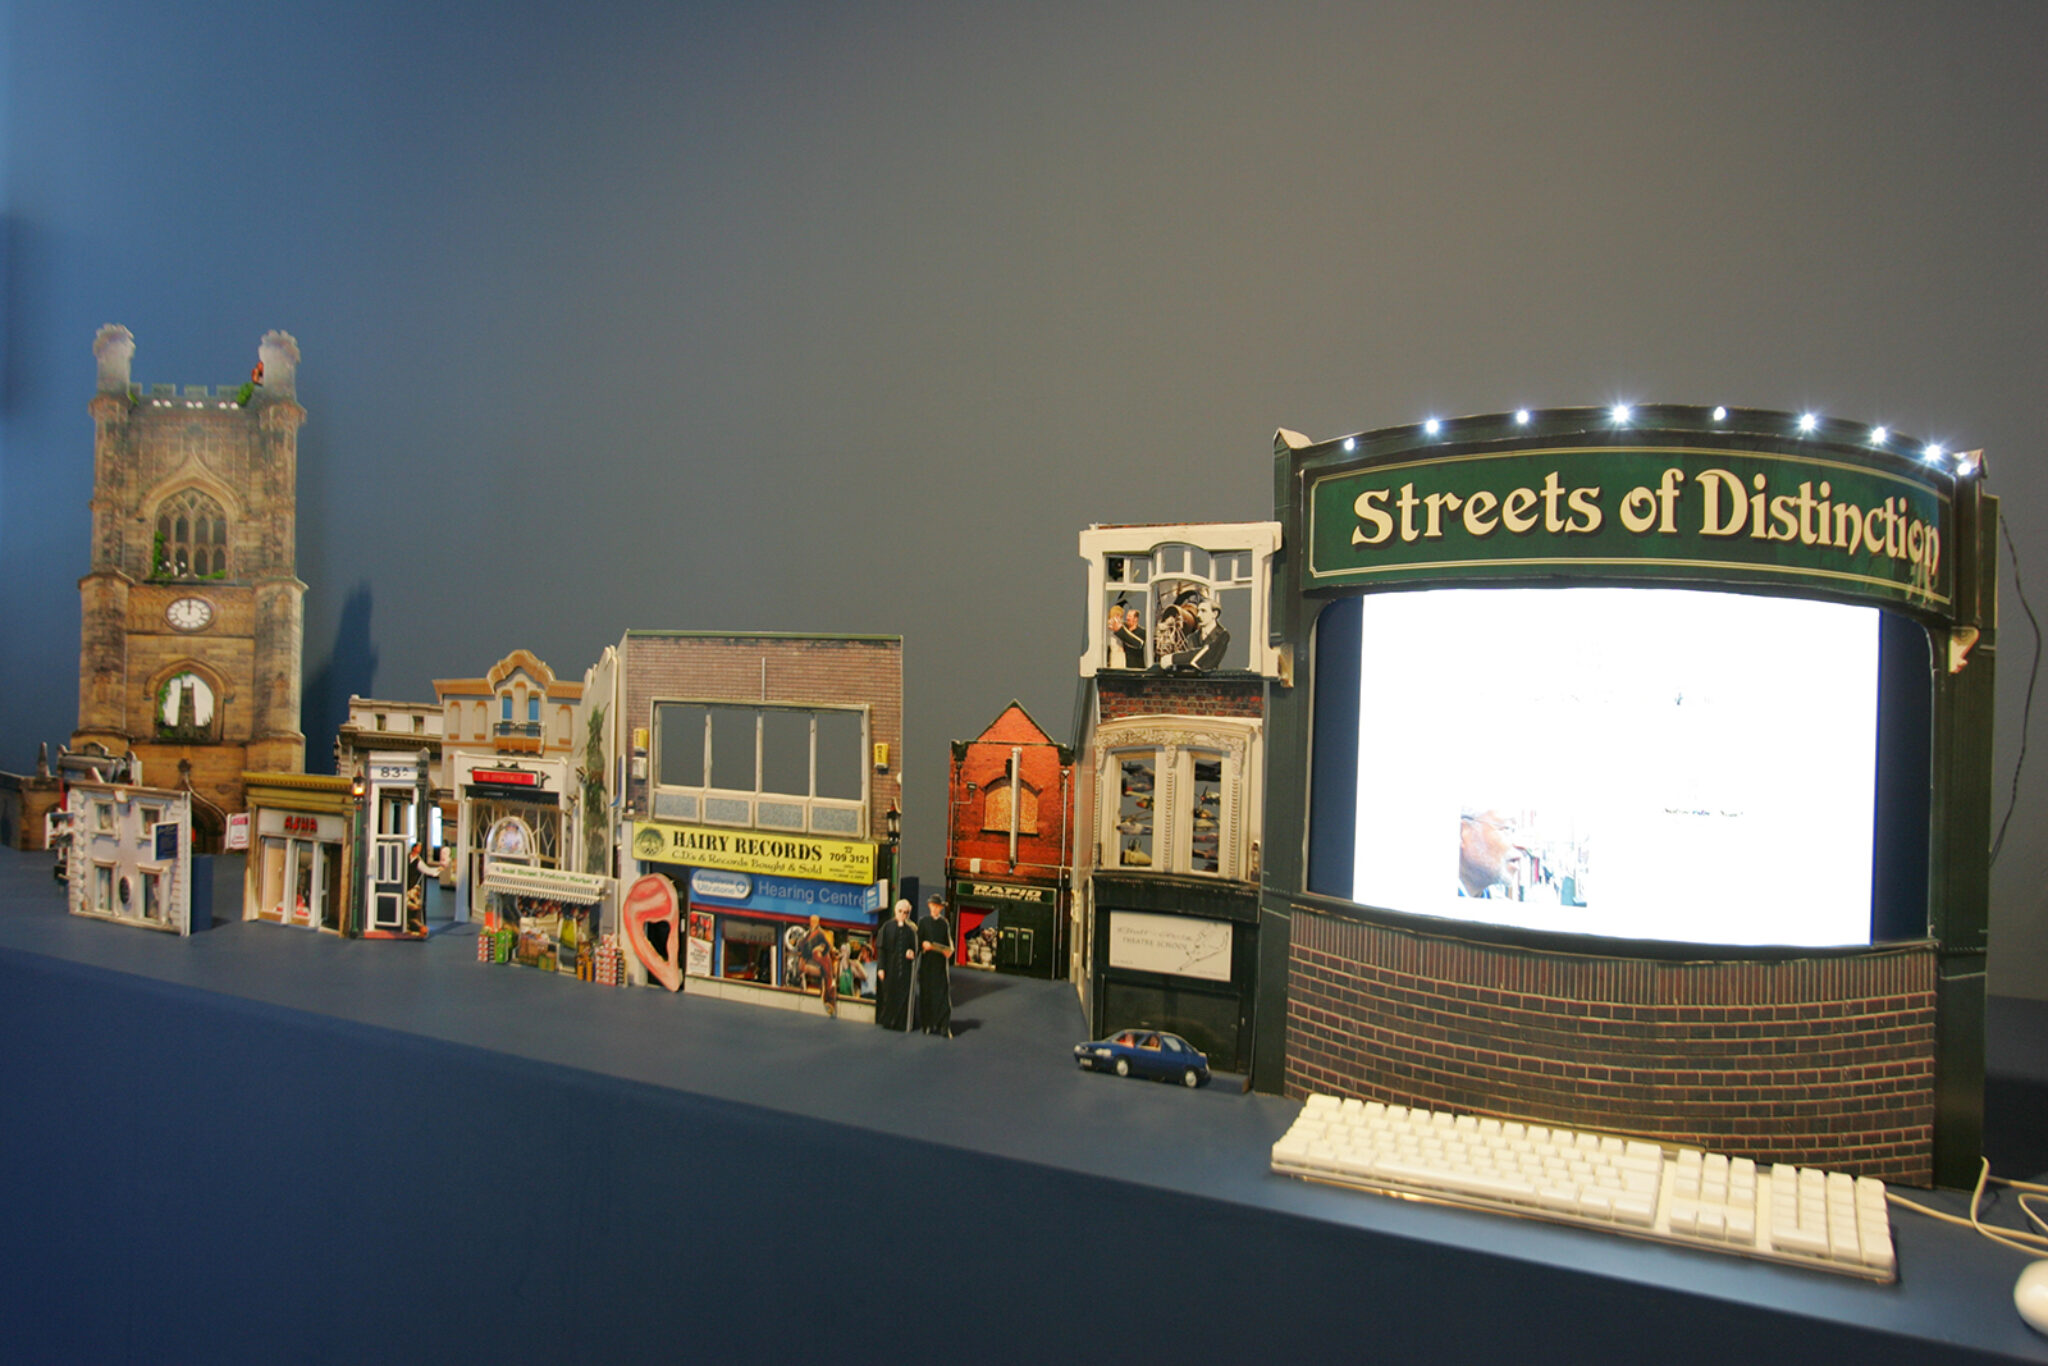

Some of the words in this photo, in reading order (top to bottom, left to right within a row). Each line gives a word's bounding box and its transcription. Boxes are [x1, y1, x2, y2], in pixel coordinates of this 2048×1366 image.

[1351, 470, 1603, 546] Streets
[1619, 467, 1685, 534] of
[1695, 467, 1940, 572] Distinction
[673, 831, 729, 852] HAIRY
[735, 837, 823, 862] RECORDS
[830, 852, 847, 861] 709
[850, 855, 870, 864] 3121
[751, 858, 786, 873] Bought
[798, 865, 823, 876] Sold
[758, 881, 815, 904] Hearing
